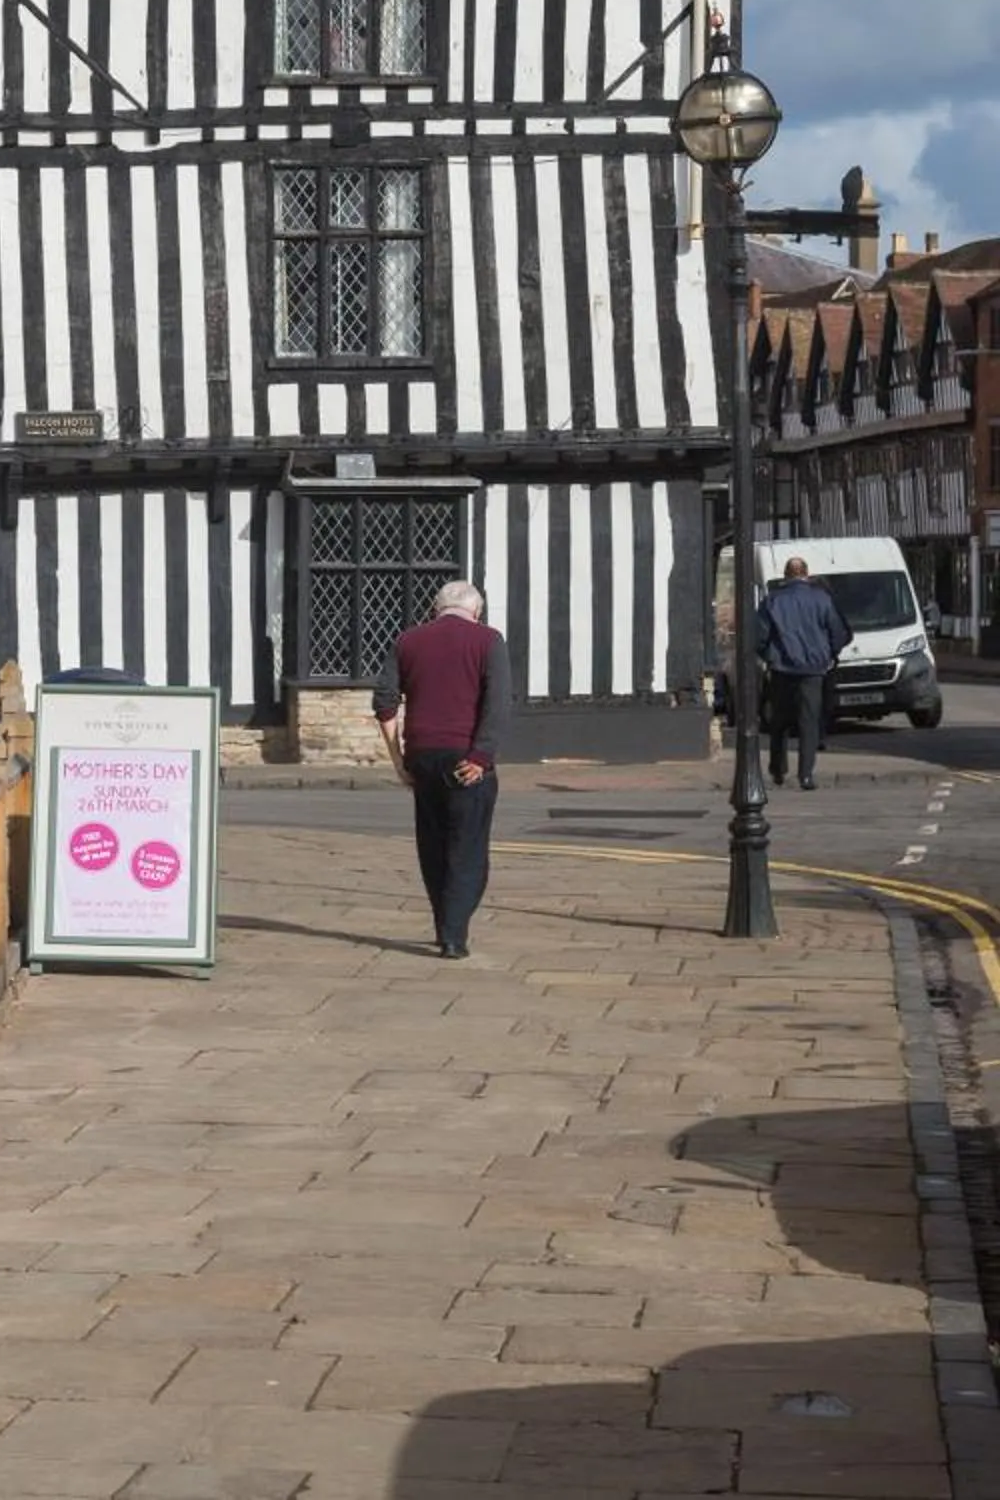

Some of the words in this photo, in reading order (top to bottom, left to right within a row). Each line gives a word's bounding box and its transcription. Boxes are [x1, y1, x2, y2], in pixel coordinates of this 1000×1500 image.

[63, 763, 149, 779] MOTHER'S
[153, 764, 188, 780] DAY
[93, 786, 152, 799] SUNDAY
